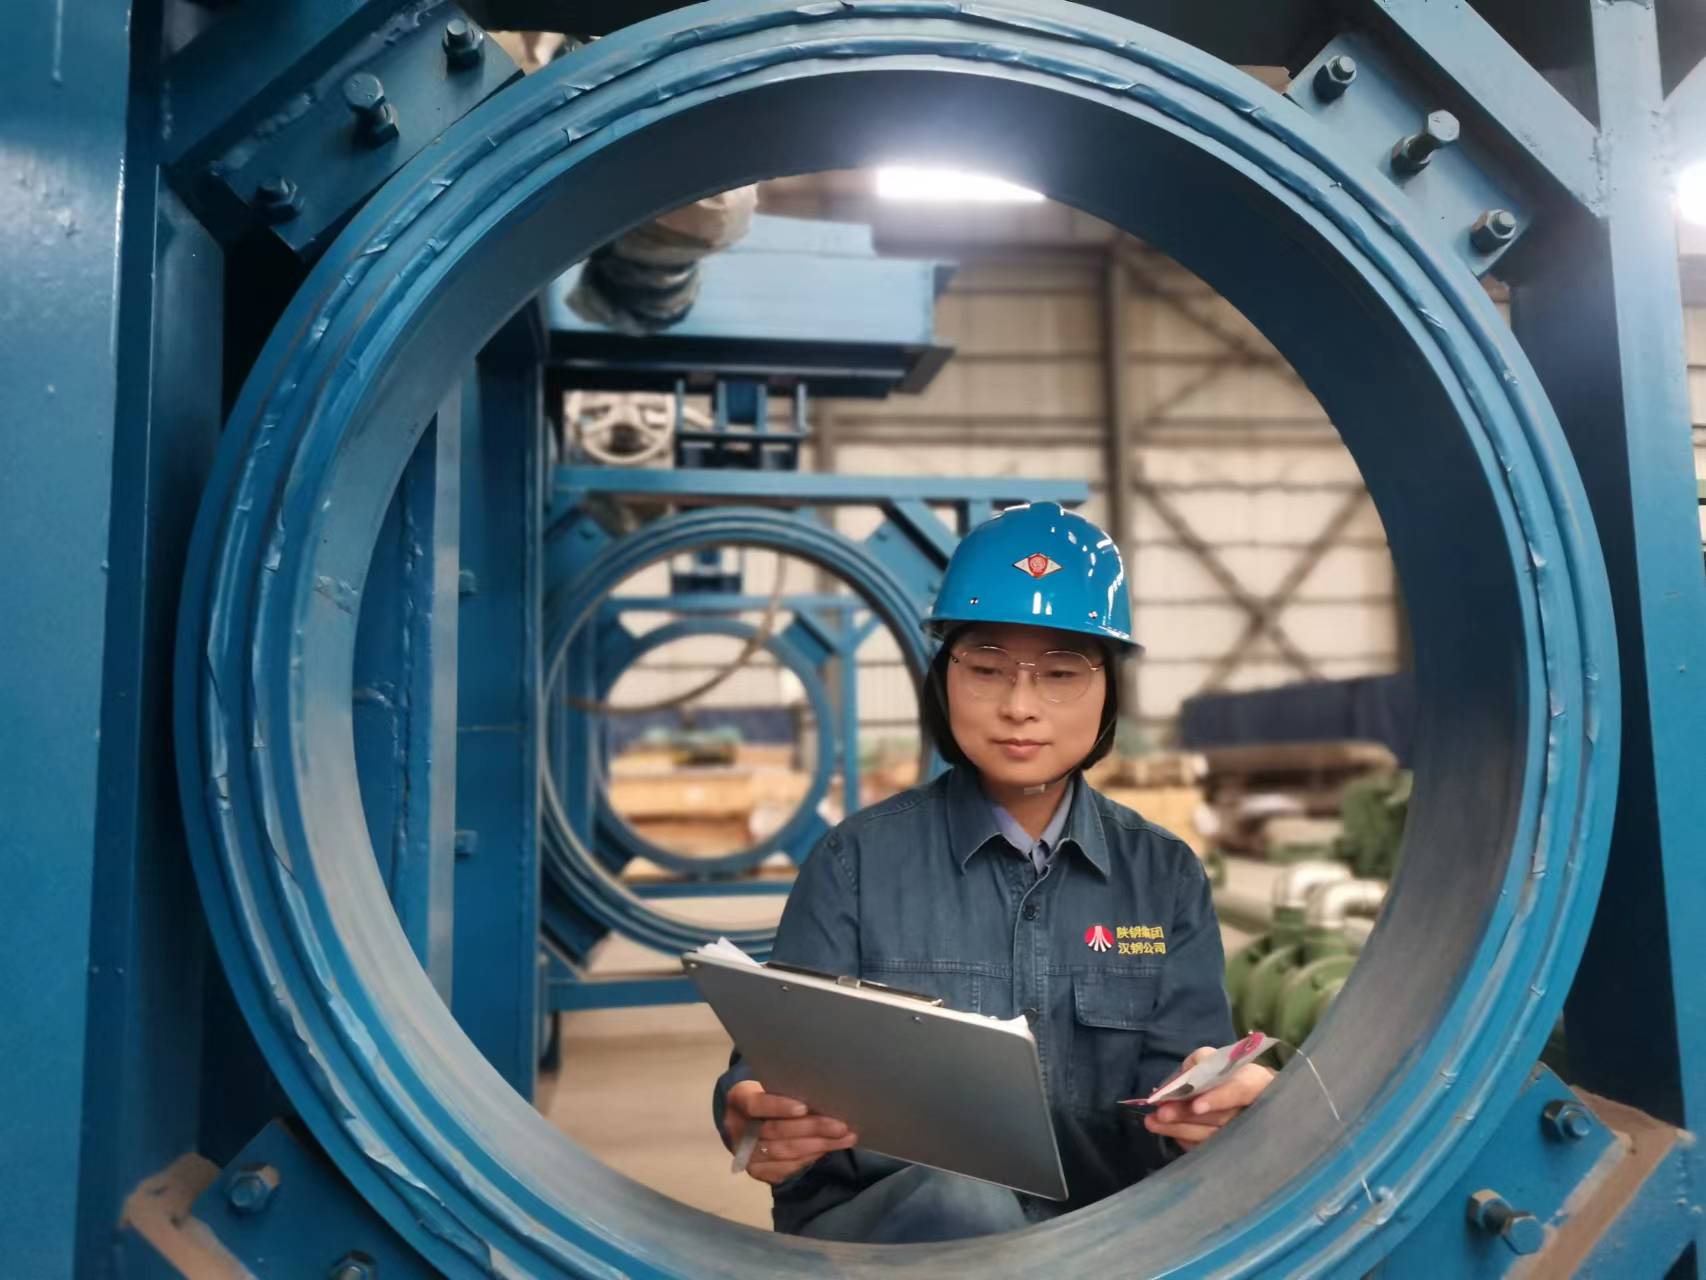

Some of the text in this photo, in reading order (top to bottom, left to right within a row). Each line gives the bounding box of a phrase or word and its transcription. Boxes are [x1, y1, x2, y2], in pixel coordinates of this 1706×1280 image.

[1116, 925, 1165, 939] 陕钢集团
[1118, 942, 1167, 954] 汉钢公司
